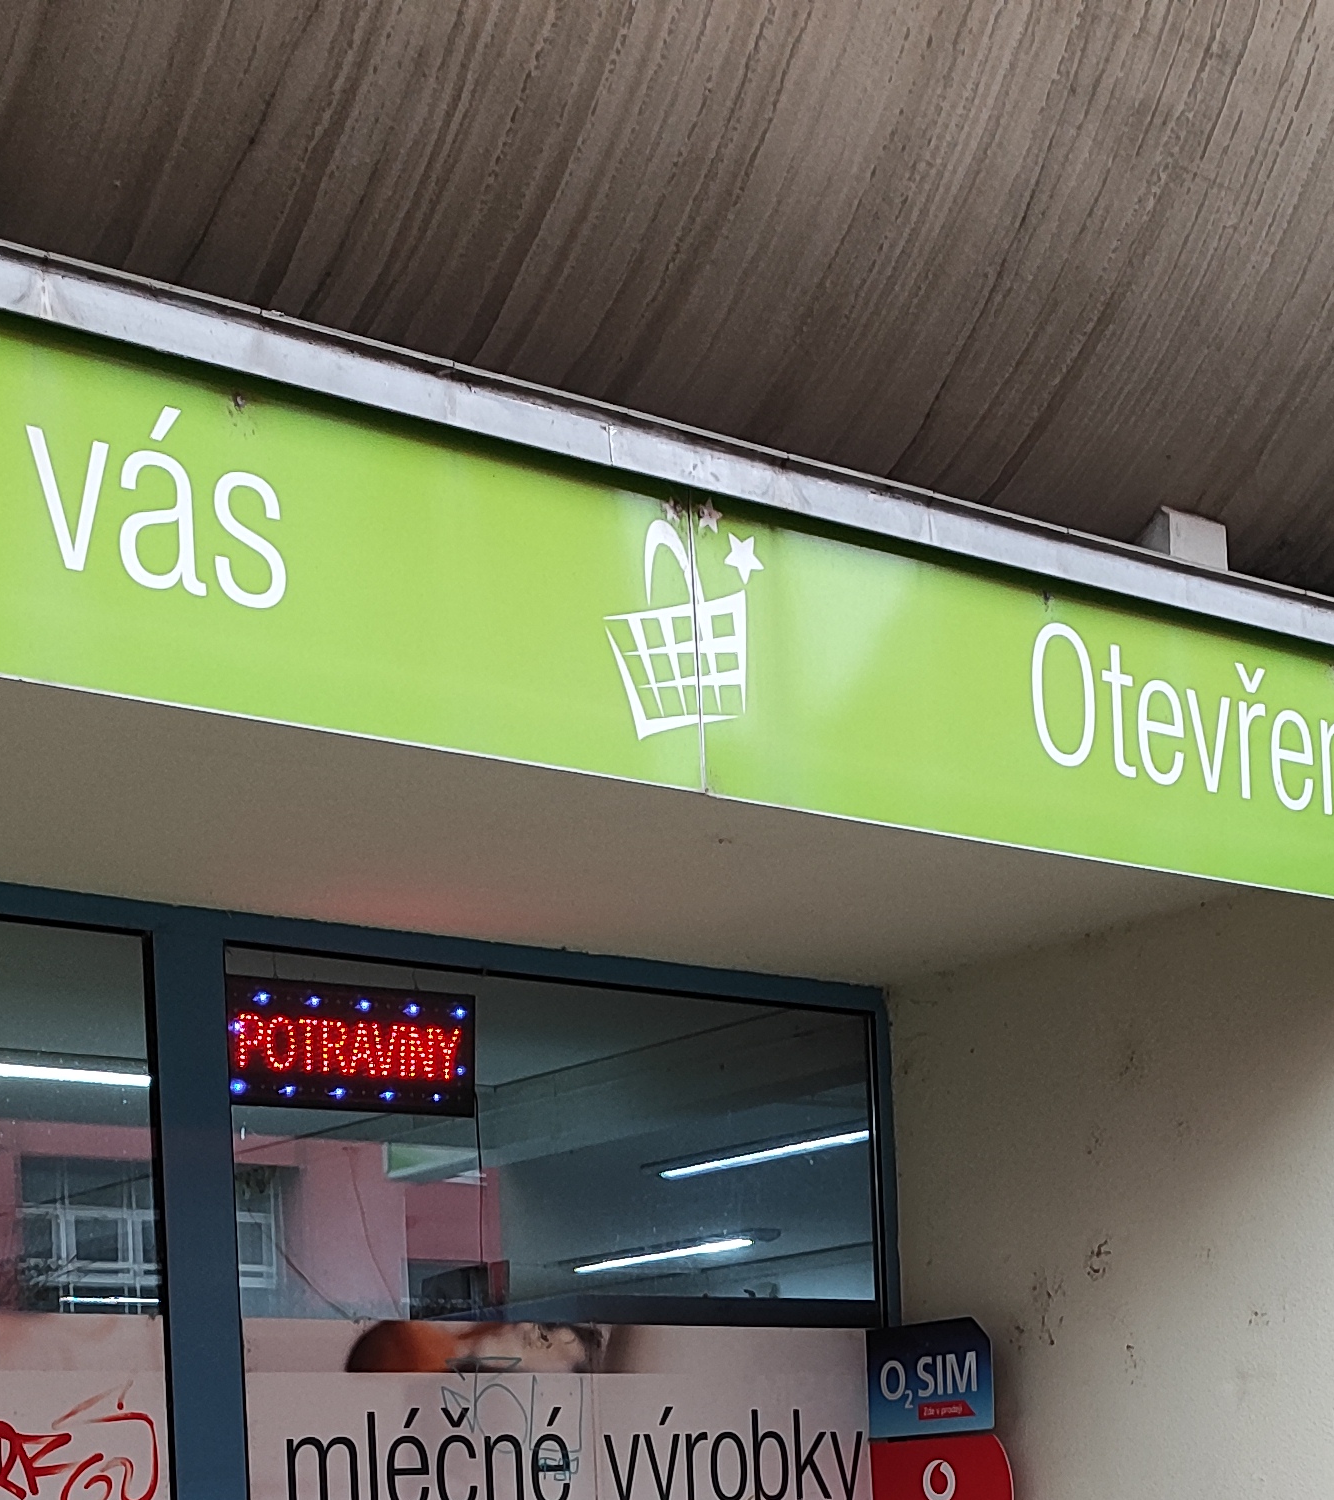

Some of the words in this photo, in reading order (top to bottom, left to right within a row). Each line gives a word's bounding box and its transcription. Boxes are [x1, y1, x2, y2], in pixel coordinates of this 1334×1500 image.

[25, 405, 288, 610] vás
[236, 1012, 463, 1081] POTRAVINY
[916, 1350, 979, 1398] SIM
